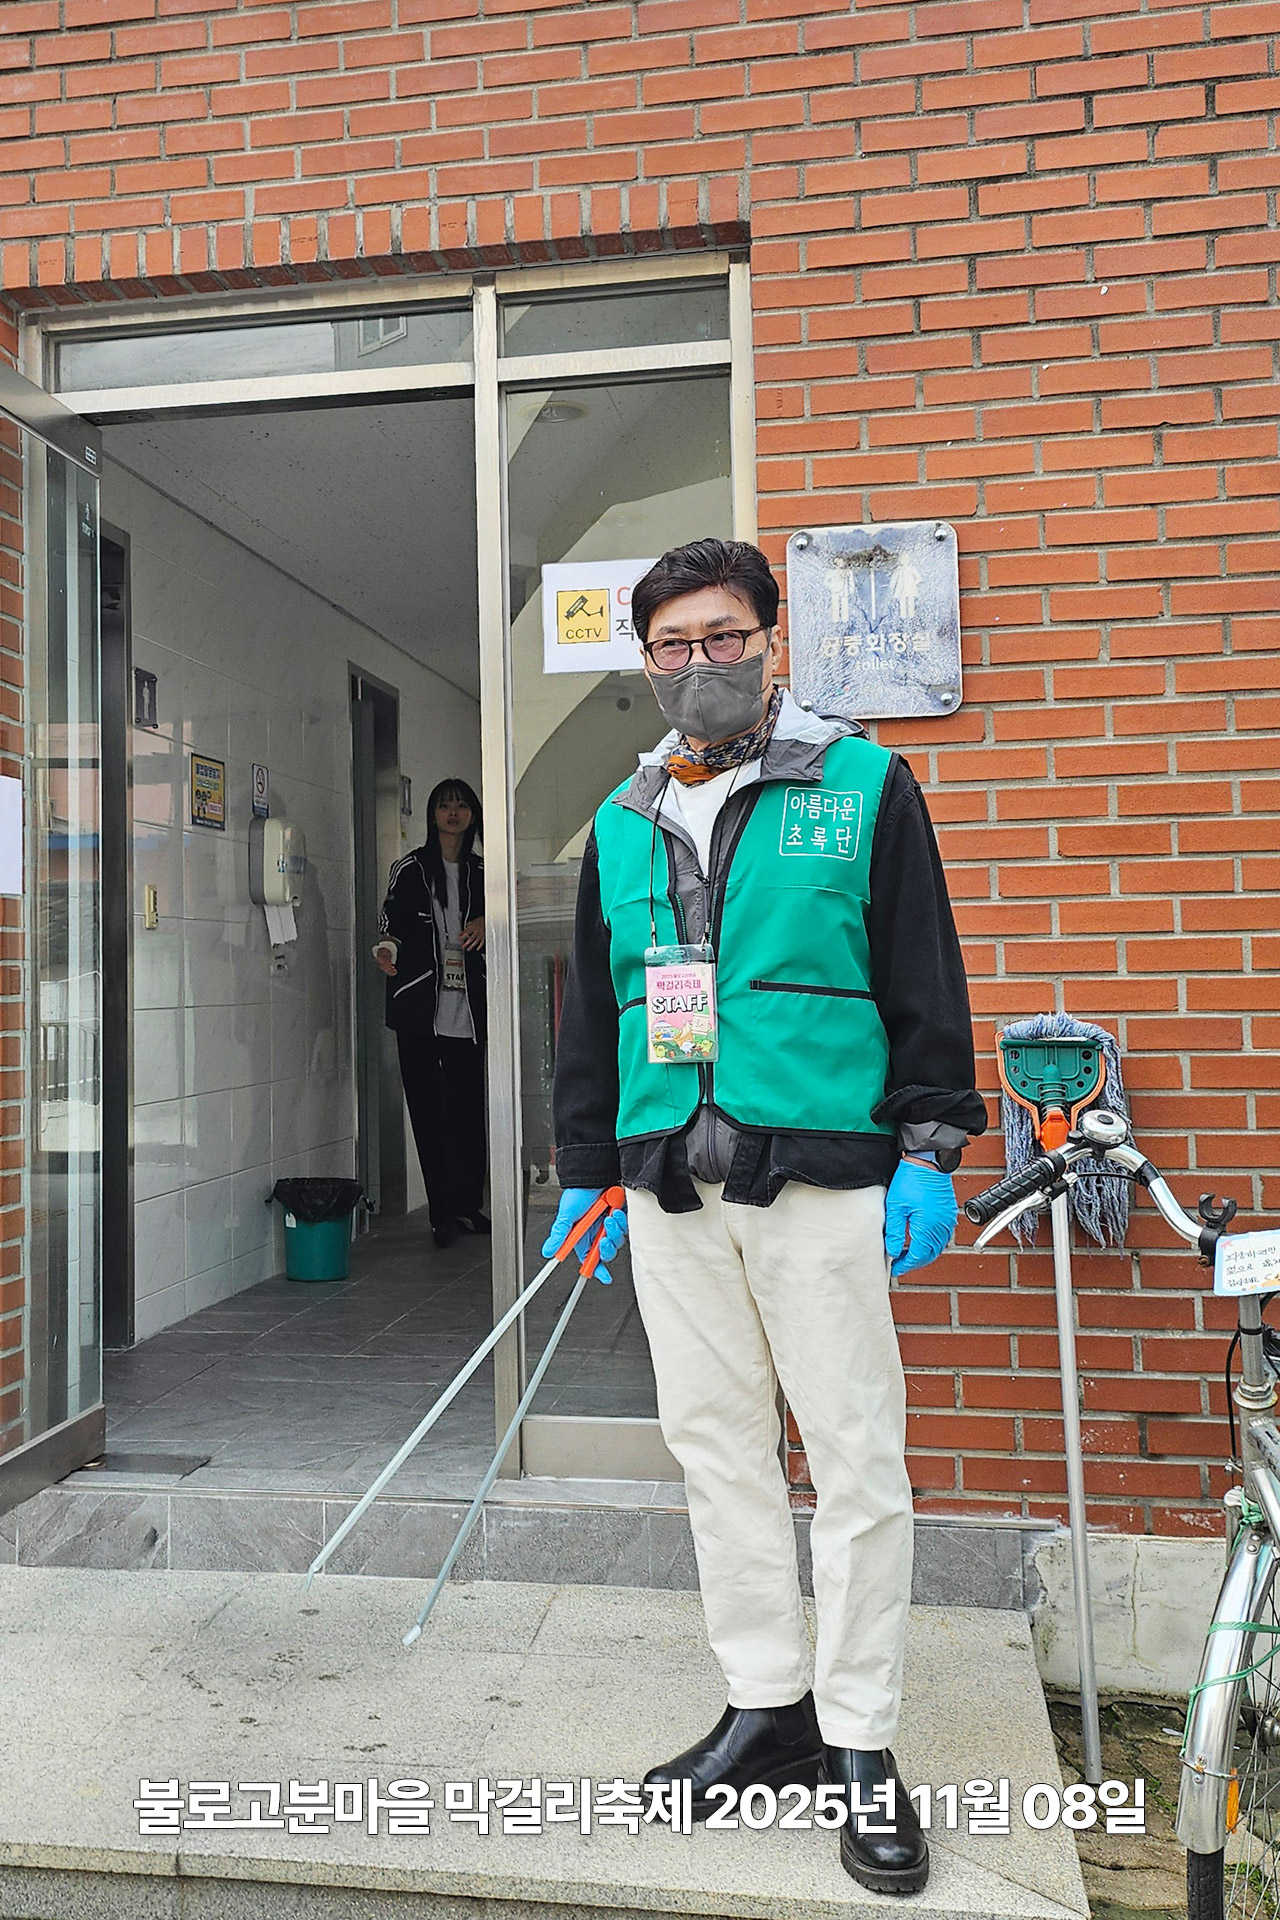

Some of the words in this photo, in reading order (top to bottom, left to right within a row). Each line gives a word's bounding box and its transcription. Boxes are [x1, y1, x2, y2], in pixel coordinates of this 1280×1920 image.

[565, 628, 602, 640] CCTV
[790, 792, 856, 822] 아름다운
[656, 979, 702, 991] 막걸리축제
[651, 993, 708, 1014] STAFF
